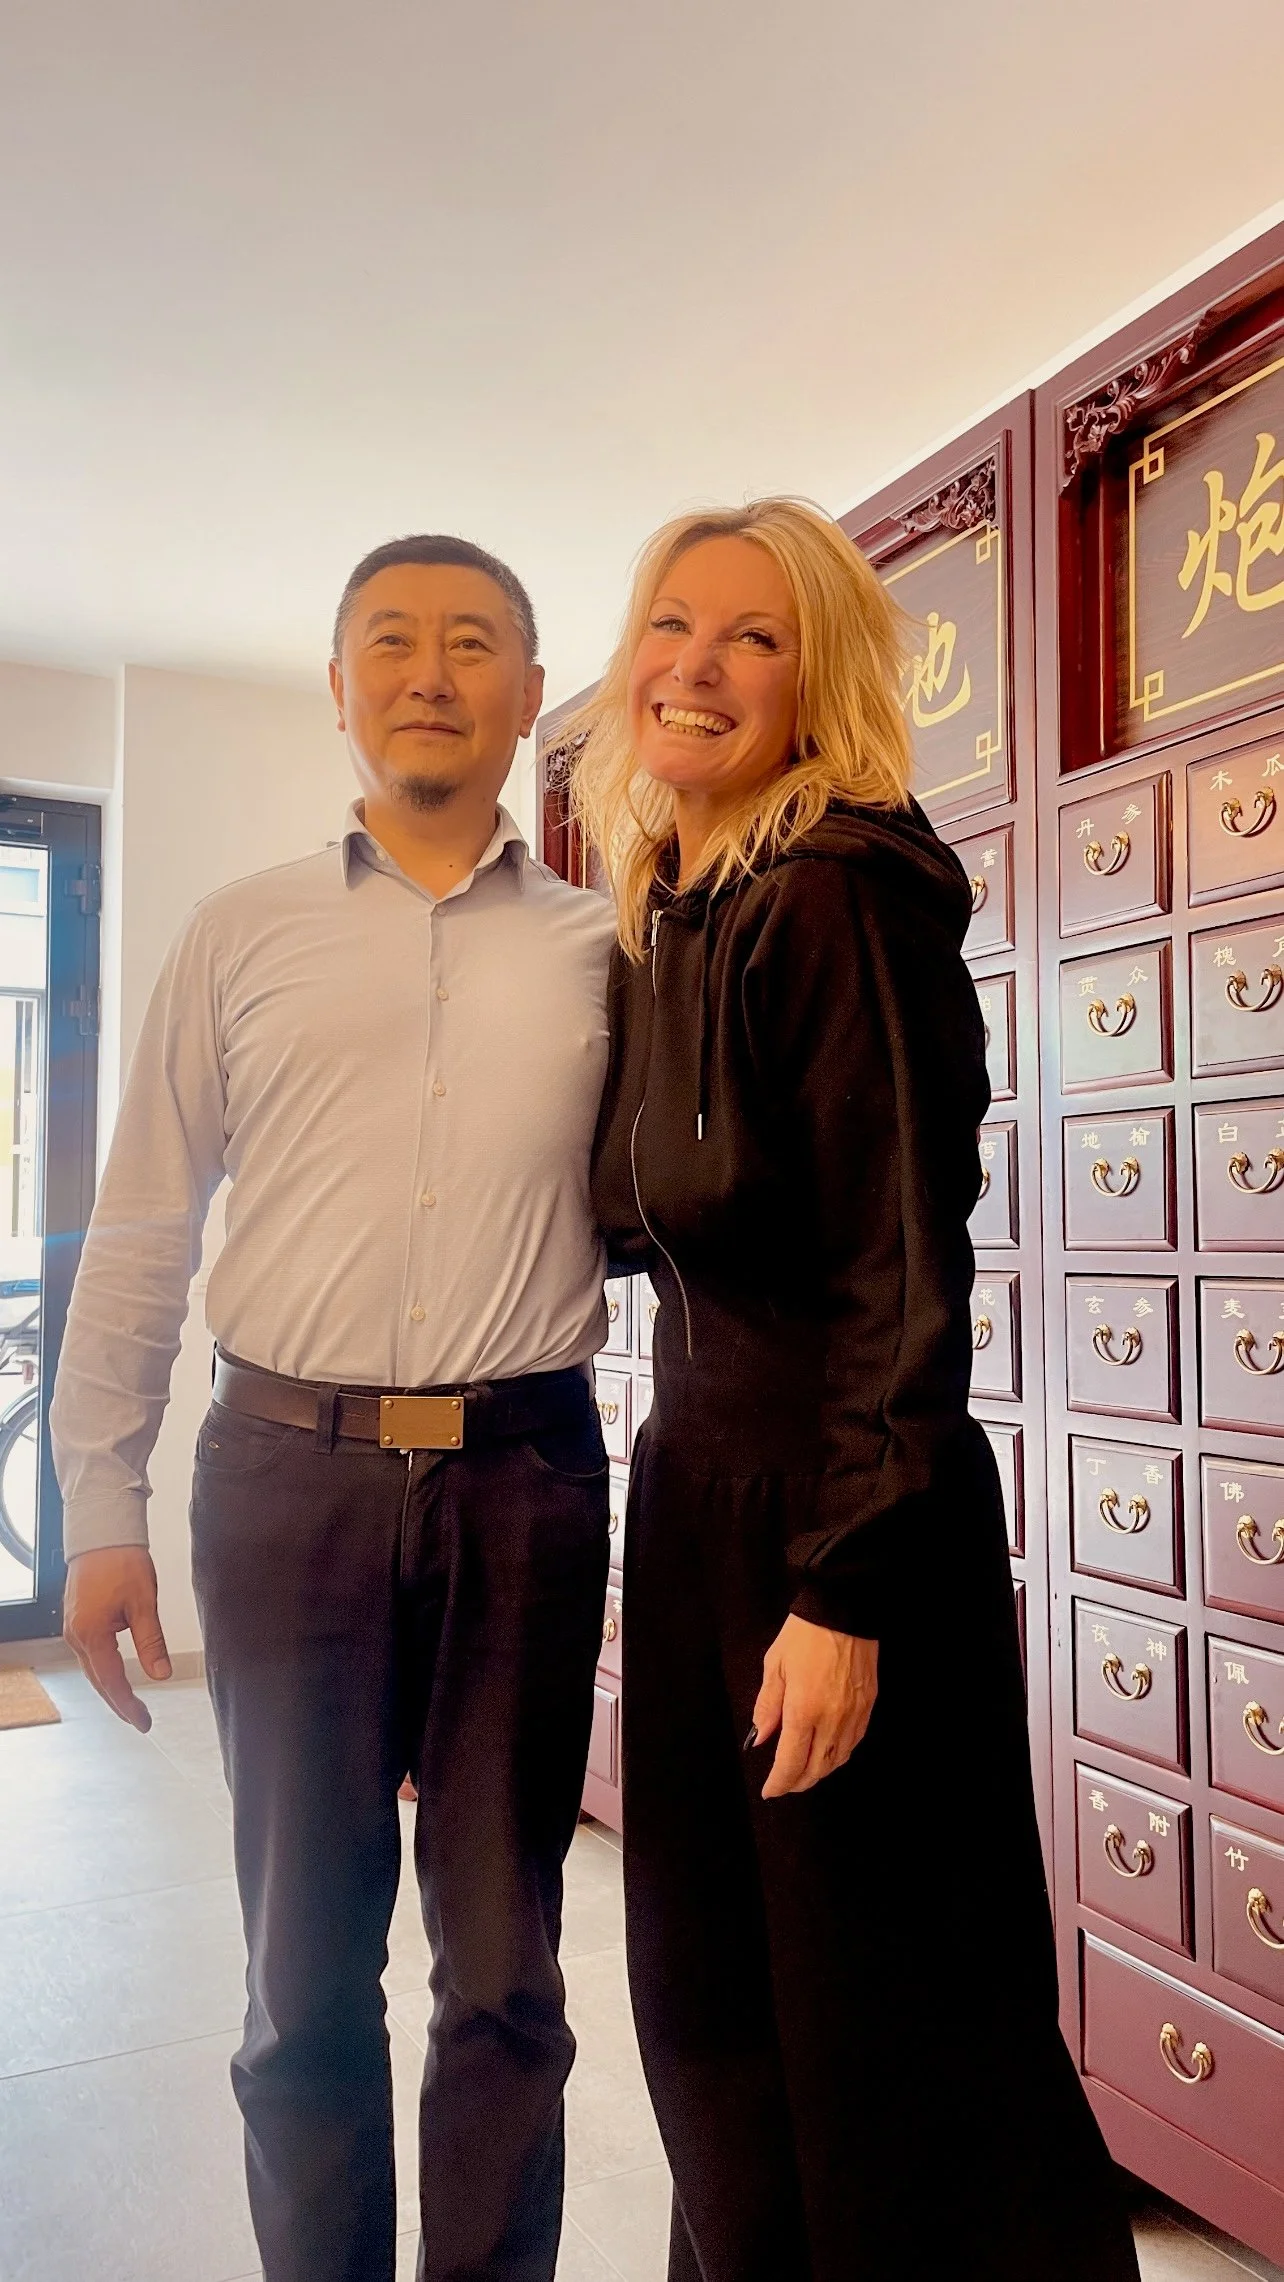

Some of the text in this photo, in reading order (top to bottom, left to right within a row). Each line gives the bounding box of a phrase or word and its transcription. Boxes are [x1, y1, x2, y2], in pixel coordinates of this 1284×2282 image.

[1209, 753, 1284, 791] 木瓜
[1075, 803, 1142, 838] 丹参
[1077, 966, 1149, 997] 贯众
[1080, 1127, 1150, 1150] 地榆
[978, 1288, 995, 1306] 花
[1084, 1295, 1153, 1318] 玄参
[1087, 1457, 1164, 1485] 丁香
[1220, 1481, 1245, 1503] 佛
[1223, 1661, 1249, 1684] 佩
[1089, 1789, 1170, 1836] 香附
[1225, 1846, 1249, 1872] 竹
